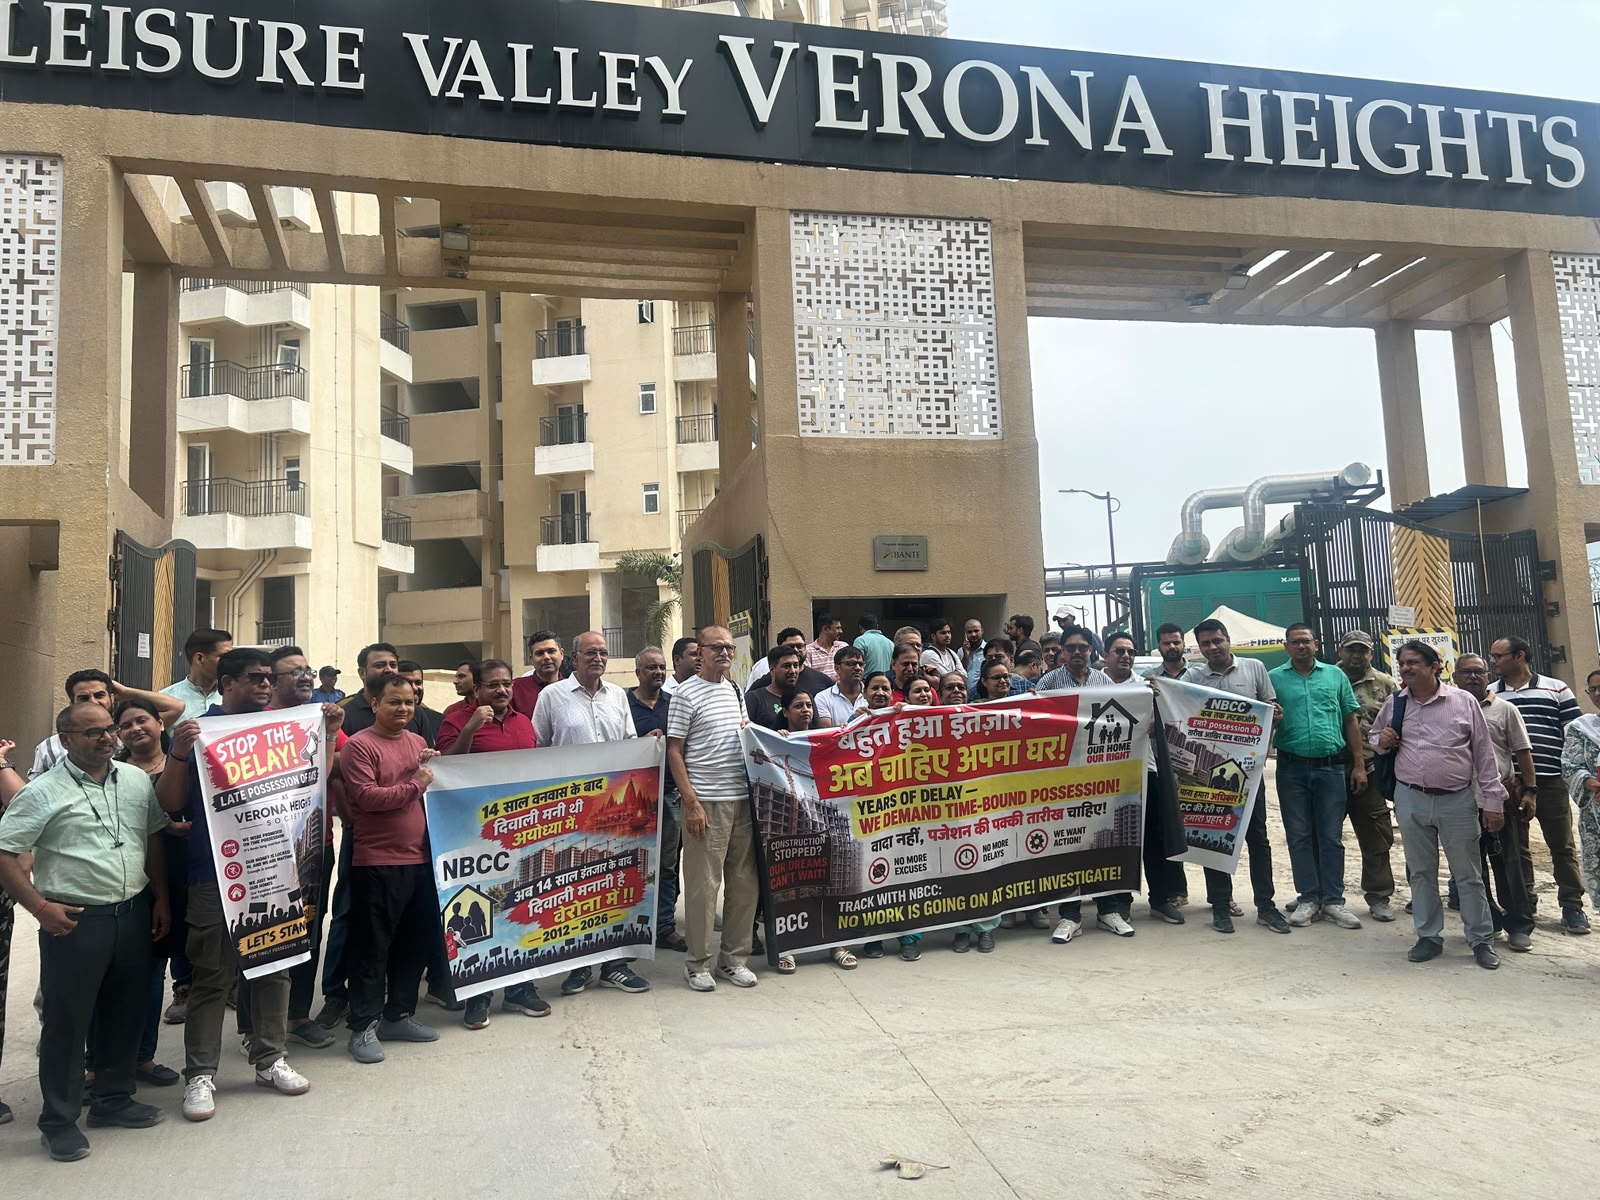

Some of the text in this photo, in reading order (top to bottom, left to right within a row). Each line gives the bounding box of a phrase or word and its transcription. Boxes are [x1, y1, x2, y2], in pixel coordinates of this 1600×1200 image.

[0, 0, 1586, 189] LEISURE VALLEY VERONA HEIGHTS
[1210, 699, 1247, 712] NBCC
[838, 722, 892, 758] बहुत
[895, 715, 943, 750] हुआ
[1209, 722, 1250, 734] possession
[1250, 726, 1260, 735] की
[216, 724, 294, 762] STOP THE
[1087, 742, 1131, 755] OUR HOME
[225, 742, 299, 785] DELAY!
[828, 733, 1068, 793] अब चाहिए अपना घर!
[1087, 751, 1130, 764] OUR RIGHT
[220, 791, 247, 807] LATE
[247, 775, 299, 798] POSSESSION
[300, 774, 309, 785] OF
[482, 777, 604, 819] 14 साल वनवास के बाद
[857, 793, 897, 816] YEARS
[900, 789, 917, 806] OF
[920, 785, 963, 803] DELAY
[1210, 791, 1238, 803] अधिकार
[235, 803, 288, 823] VERONA
[493, 798, 585, 837] दिवाली मनी थी
[859, 778, 1120, 835] WE DEMAND TIME-BOUND POSSESSION!
[1193, 803, 1203, 812] की
[1203, 804, 1215, 813] देरी
[1215, 806, 1225, 814] पर
[871, 800, 1107, 853] वादा नहीं, पजेशन की पक्की तारीख चाहिए!
[1183, 814, 1205, 823] हमारा
[1225, 813, 1232, 826] है
[512, 821, 562, 847] अयोध्या
[771, 834, 826, 851] CONSTRUCTION
[1053, 826, 1086, 838] WE WANT
[1053, 836, 1081, 847] ACTION!
[775, 846, 823, 861] STOPPED?
[982, 839, 1009, 853] NO MORE
[983, 849, 1005, 862] DELAYS
[443, 851, 510, 882] NBCC
[769, 857, 828, 877] OUR DREAMS
[894, 853, 928, 866] NO MORE
[895, 863, 928, 876] EXCUSES
[514, 885, 533, 903] अब
[536, 878, 553, 894] 14
[555, 870, 579, 886] साल
[580, 861, 608, 880] इंतजार
[608, 859, 617, 870] के
[770, 869, 826, 890] CAN'T WAIT!
[528, 871, 626, 918] दिवाली मनानी है
[553, 895, 601, 923] वेरोना
[606, 887, 620, 905] में
[838, 865, 1122, 929] NO WORK IS GOING ON AT SITE! INVESTIGATE!
[838, 884, 942, 913] TRACK WITH NBCC:
[247, 930, 276, 950] LET'S
[542, 914, 608, 943] 2012 2026
